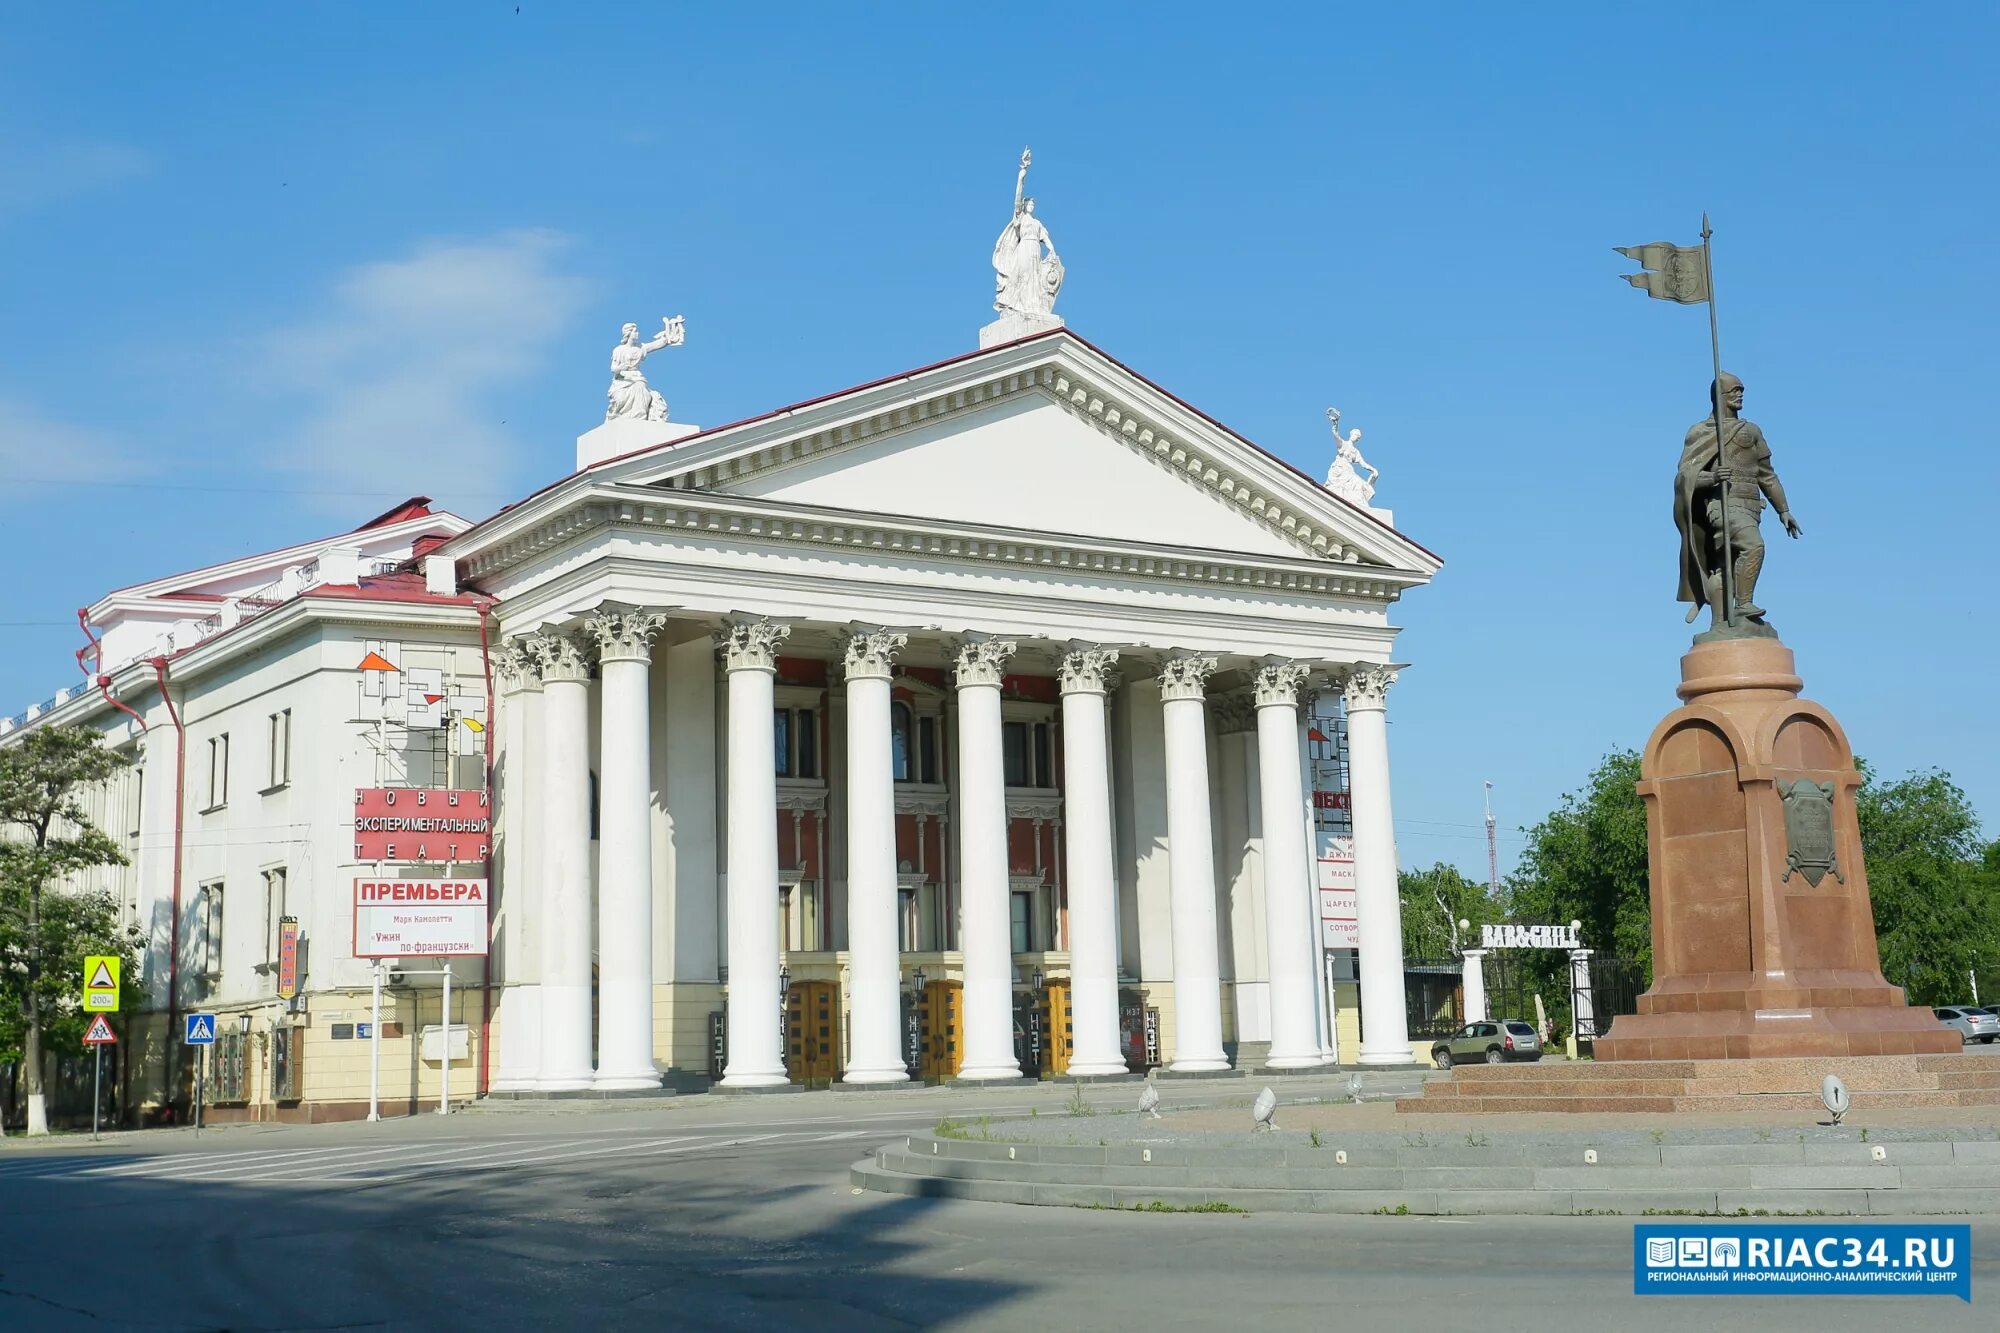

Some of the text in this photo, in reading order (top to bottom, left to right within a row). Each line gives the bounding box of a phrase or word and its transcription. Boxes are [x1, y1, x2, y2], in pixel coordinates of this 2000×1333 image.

[355, 791, 488, 806] НОВЫЙ
[355, 816, 488, 833] ЭКСПЕРИМЕНТАЛЬНЫЙ
[355, 843, 488, 859] ТЕАТР
[361, 883, 482, 900] ПРЕМЬЕРА
[393, 915, 412, 925] Марк
